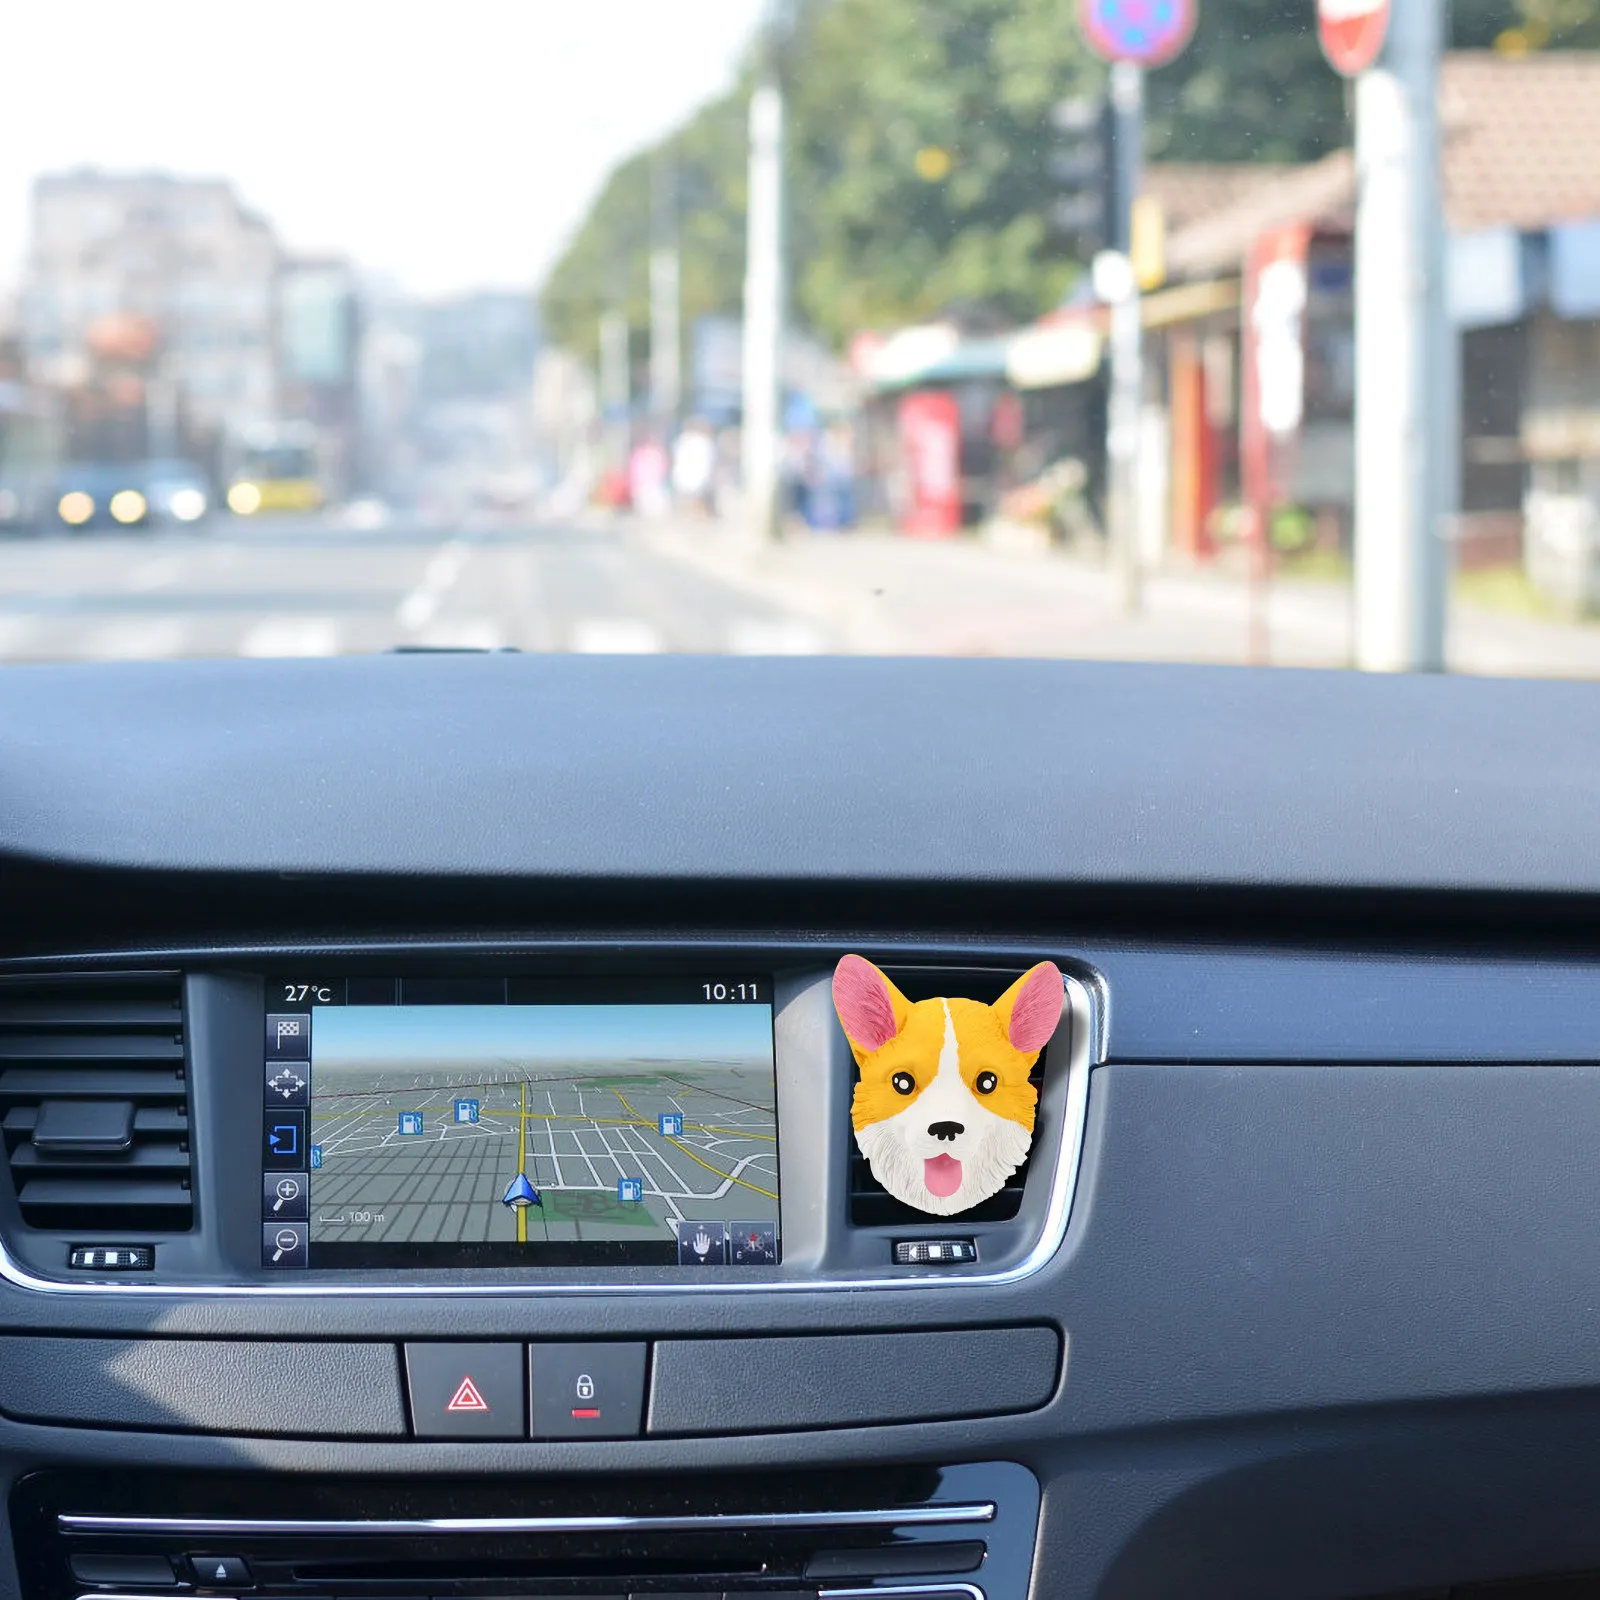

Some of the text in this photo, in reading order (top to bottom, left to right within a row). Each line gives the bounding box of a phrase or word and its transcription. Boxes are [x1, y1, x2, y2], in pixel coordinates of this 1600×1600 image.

[284, 984, 331, 1002] 27°C
[702, 983, 757, 1000] 10:11
[350, 1211, 385, 1222] 100 m
